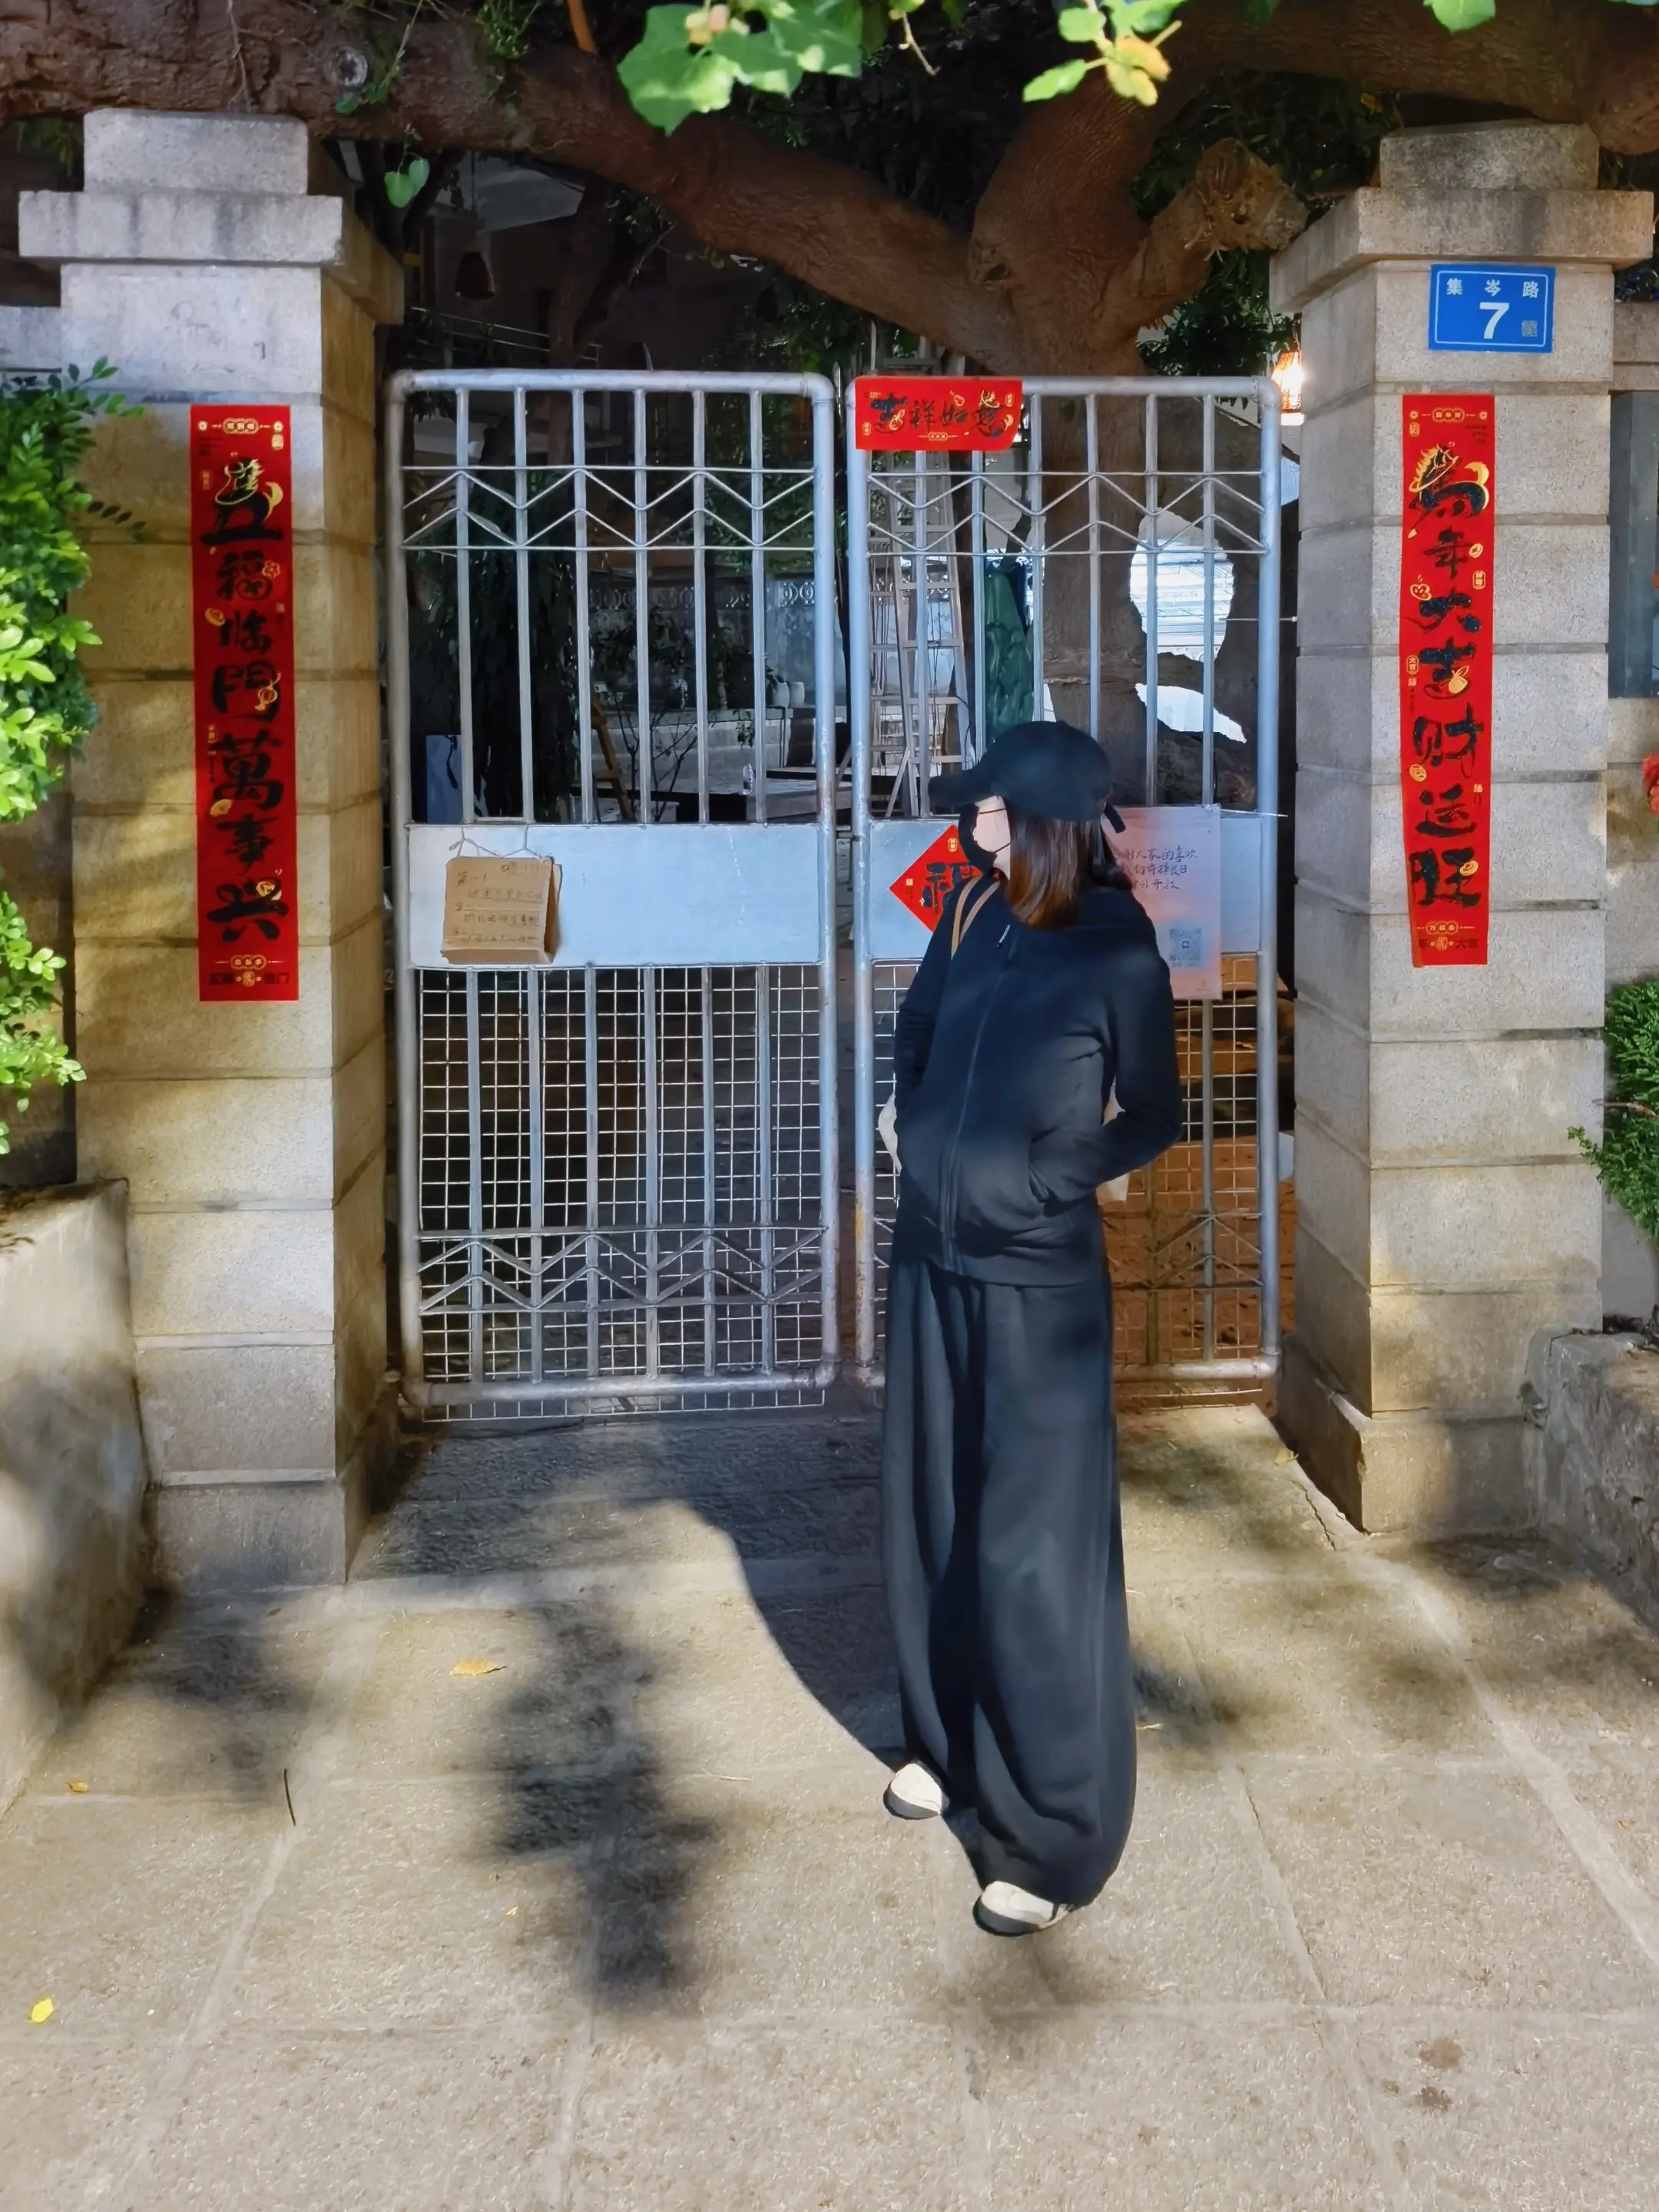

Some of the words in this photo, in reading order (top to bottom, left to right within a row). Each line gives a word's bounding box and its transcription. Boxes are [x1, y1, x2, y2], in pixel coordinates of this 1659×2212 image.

[1446, 277, 1539, 298] 集岑路
[1479, 302, 1509, 339] 7
[869, 389, 1007, 439] 吉祥如意
